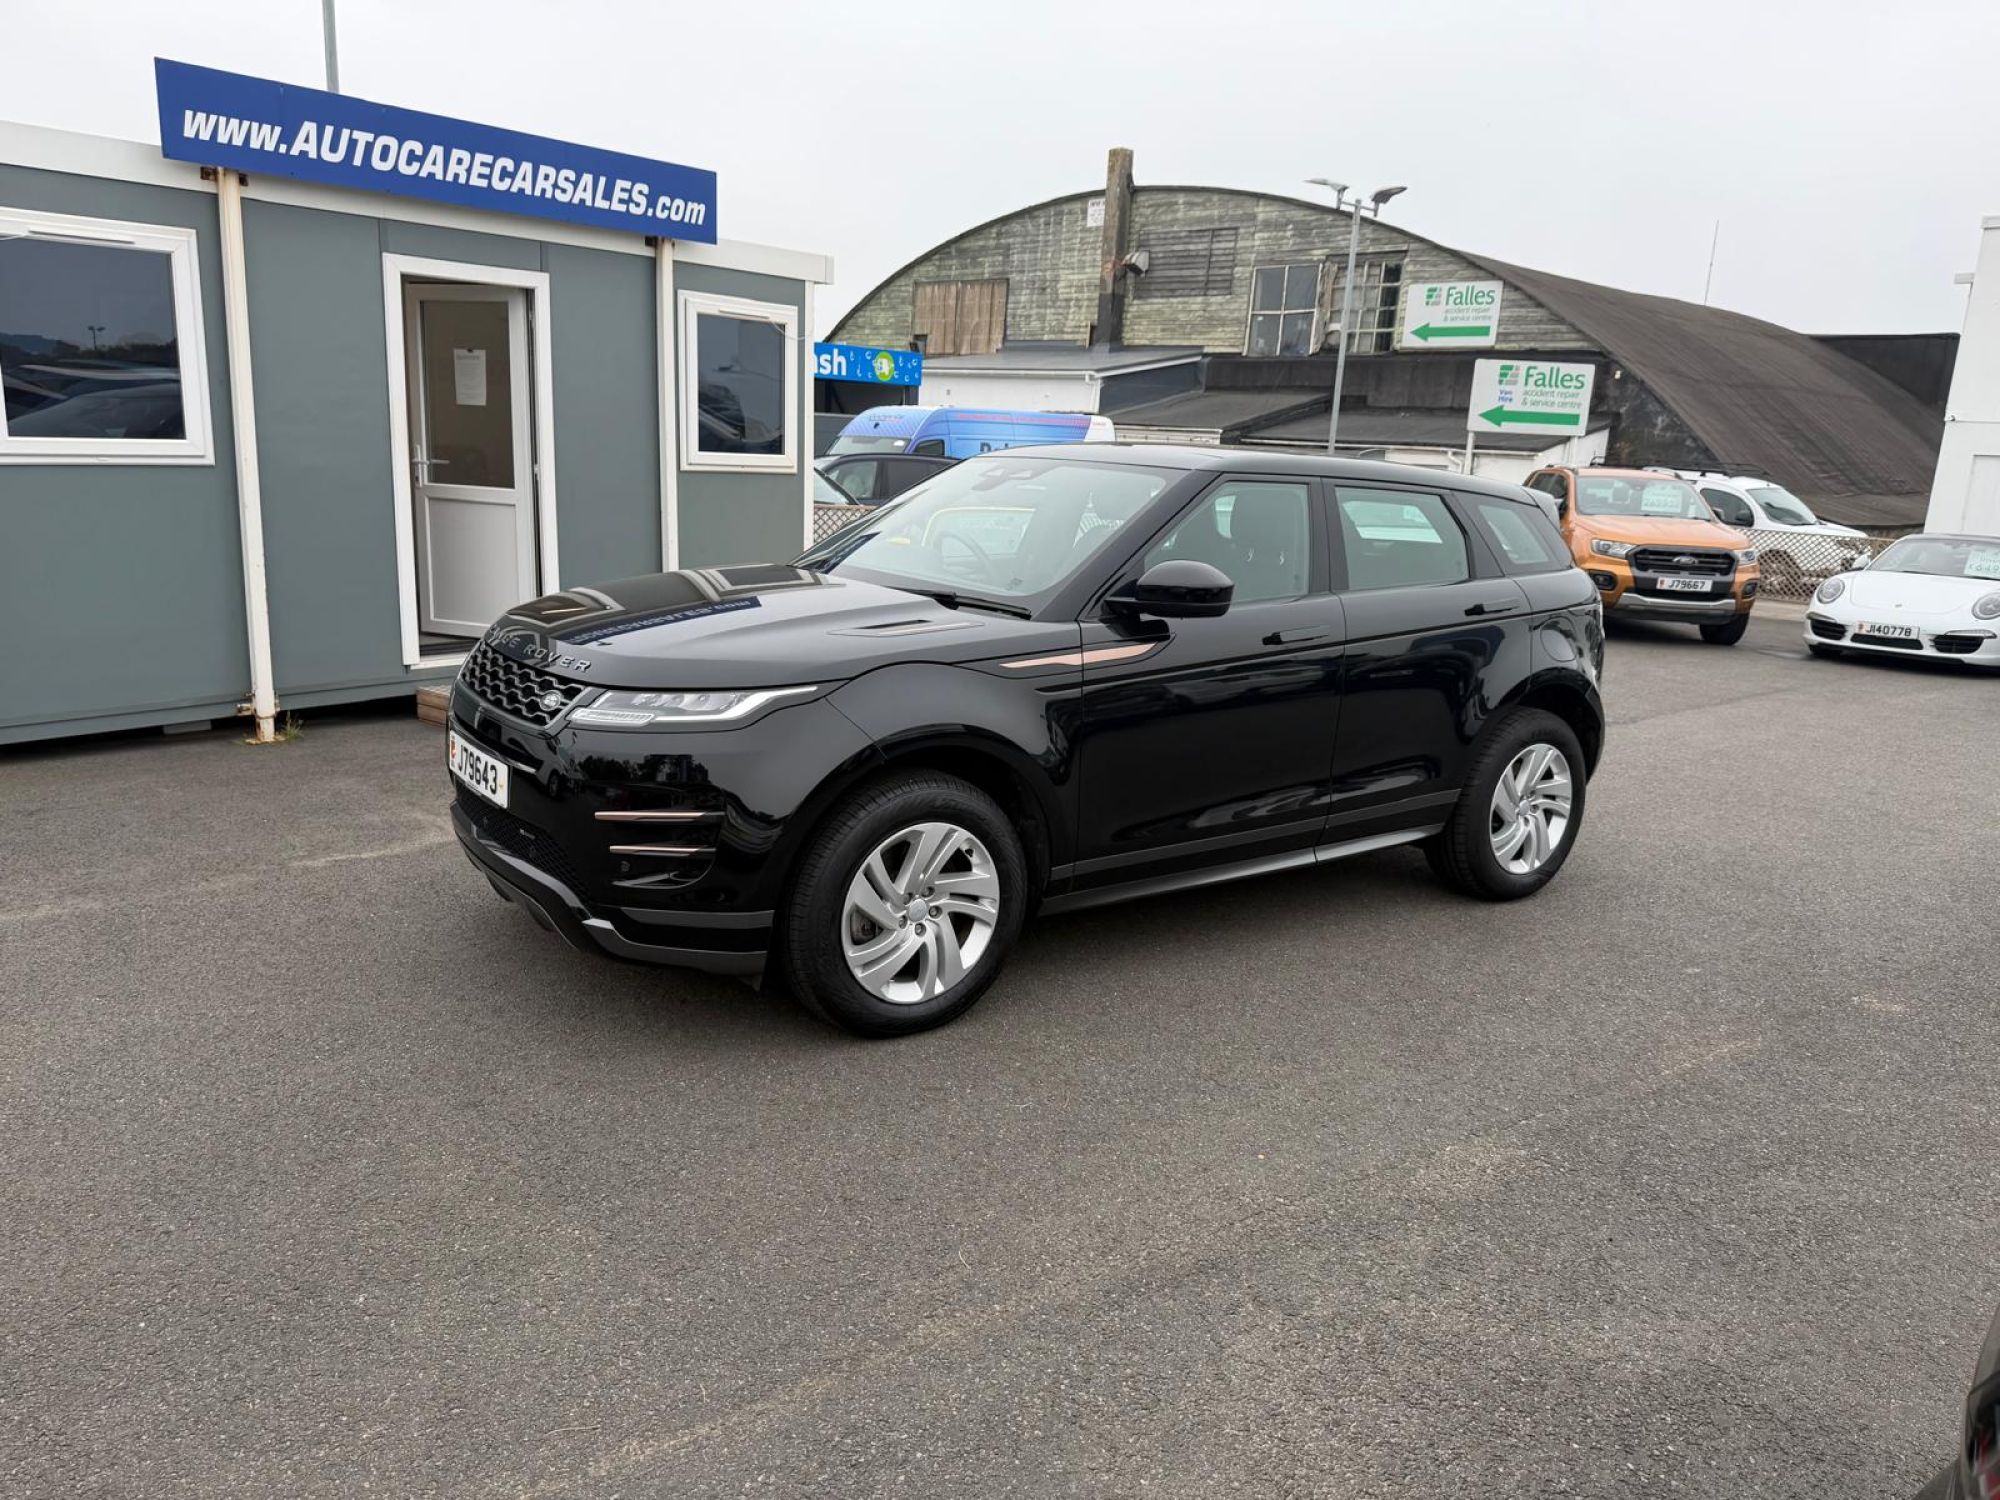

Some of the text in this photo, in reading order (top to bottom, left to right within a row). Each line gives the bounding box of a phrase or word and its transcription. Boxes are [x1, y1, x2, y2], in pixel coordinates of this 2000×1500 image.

[182, 109, 706, 225] www.AUTOCARECARSALES.com
[1445, 285, 1495, 305] Falles
[1524, 365, 1585, 389] Falles
[1523, 389, 1580, 399] accident repair
[523, 644, 592, 673] ROVER
[458, 744, 498, 795] J79643
